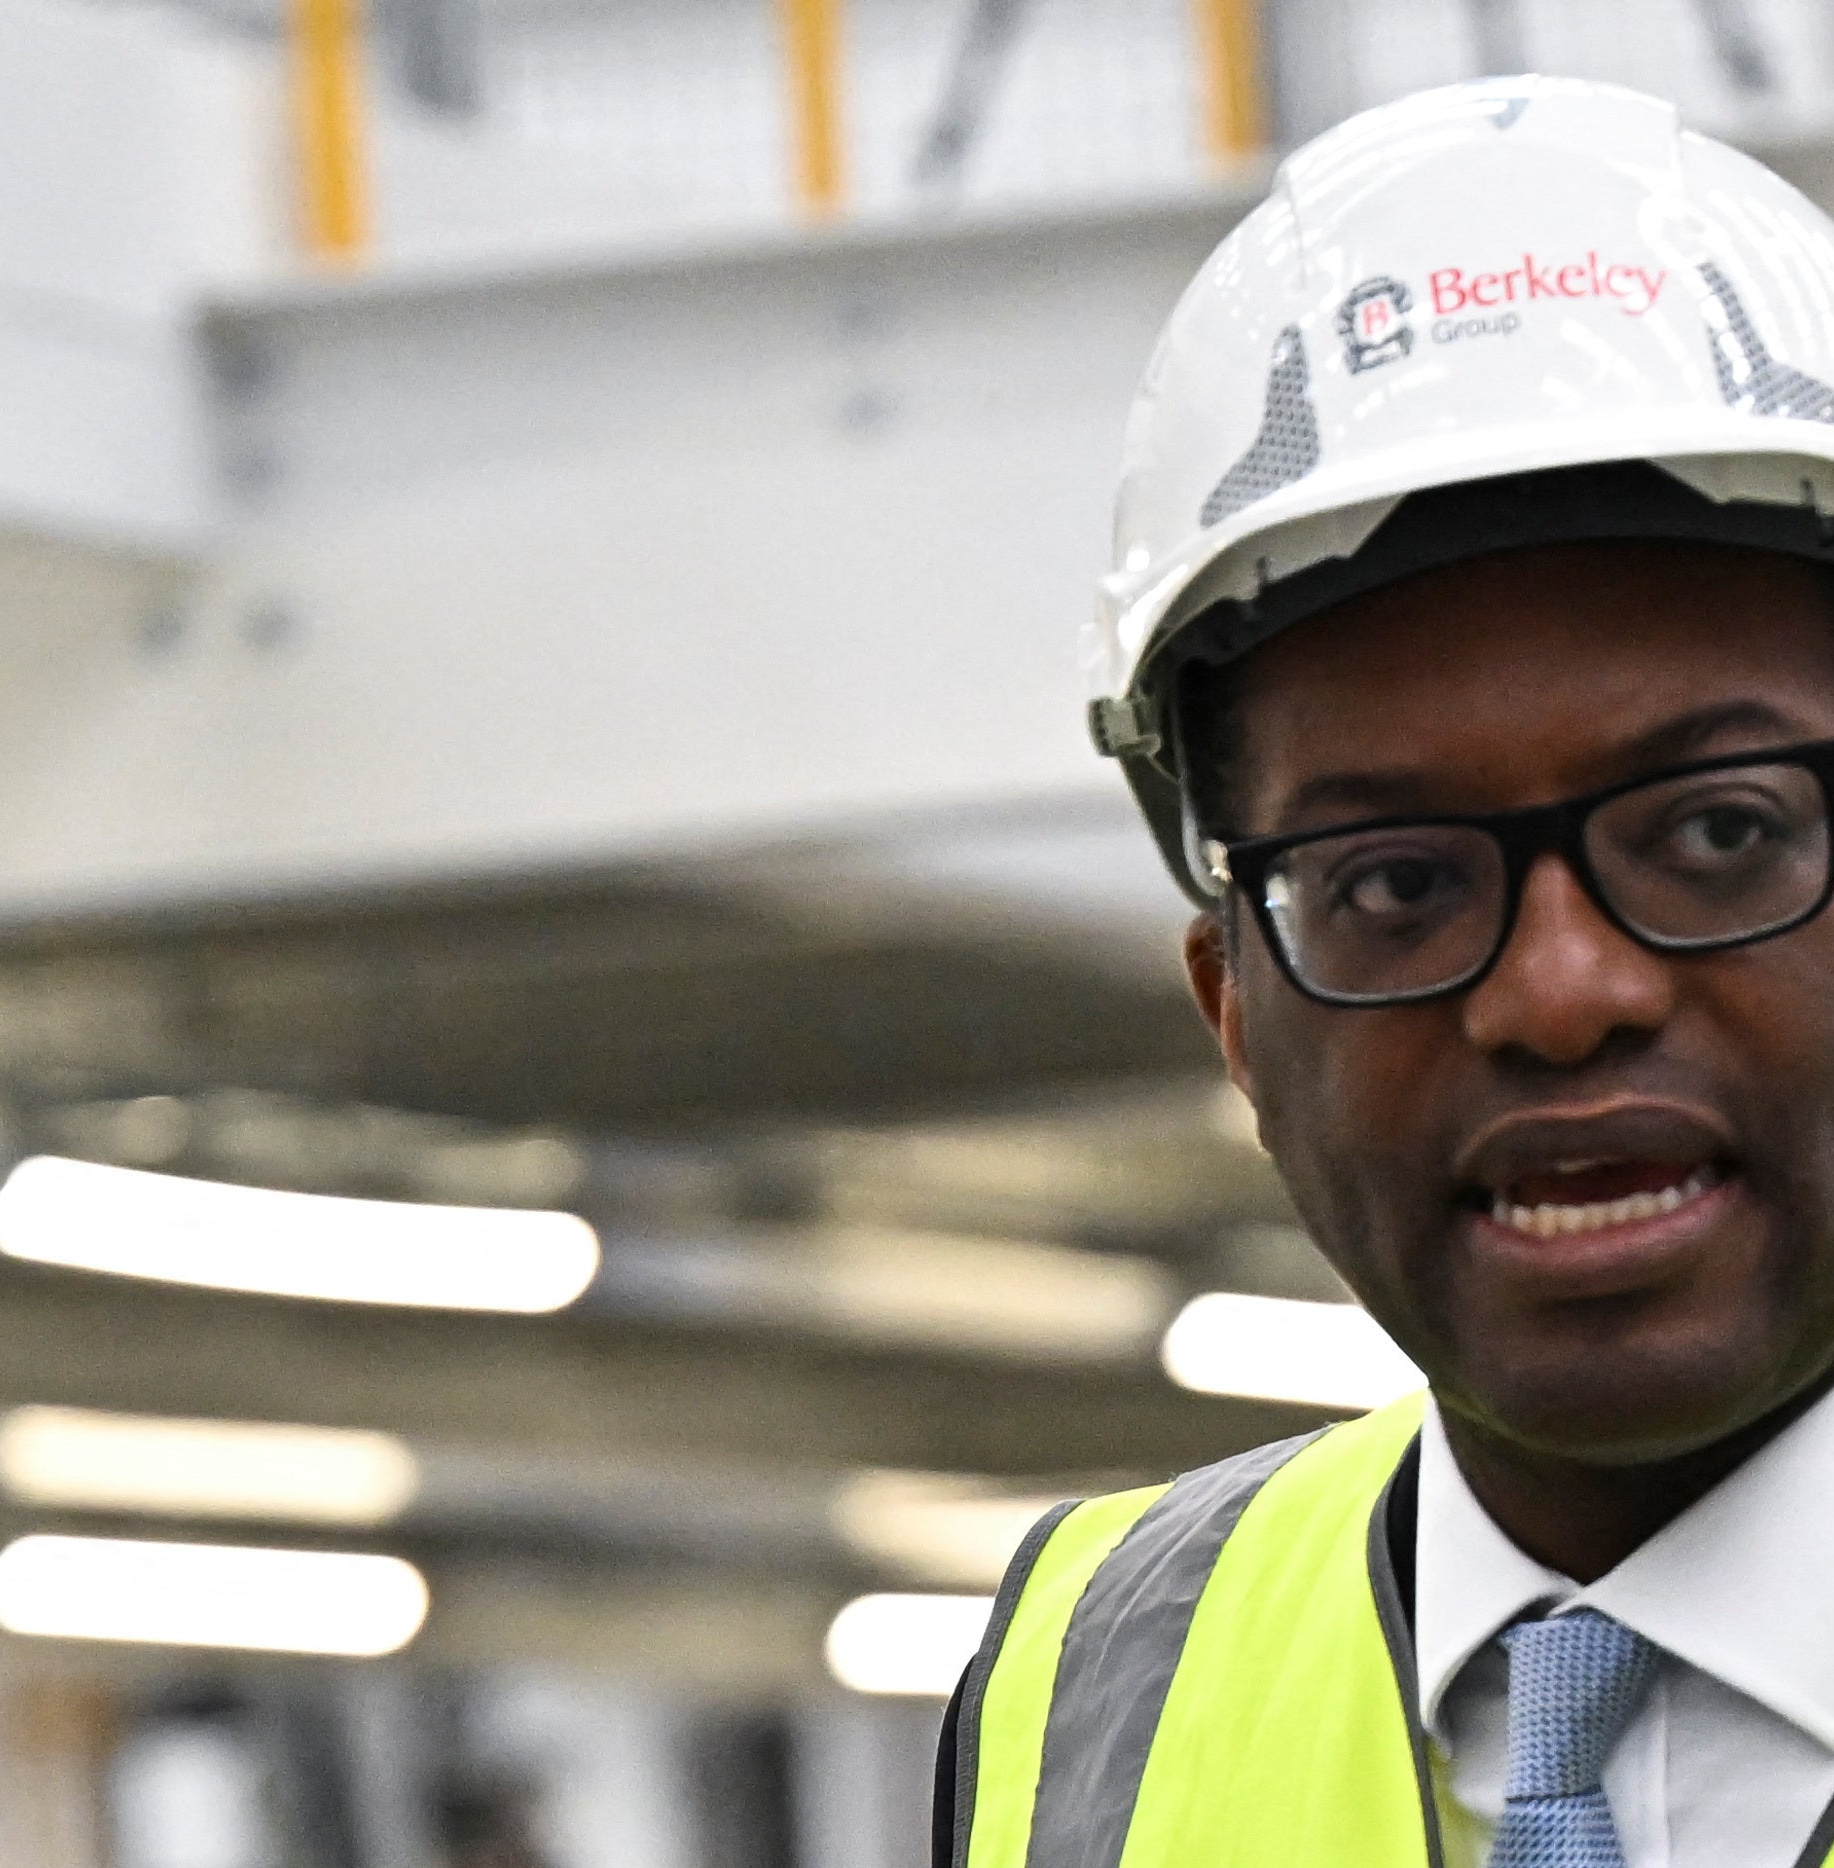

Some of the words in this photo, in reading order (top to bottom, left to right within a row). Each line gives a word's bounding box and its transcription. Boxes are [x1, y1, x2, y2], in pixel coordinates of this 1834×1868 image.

[1428, 249, 1667, 317] Berkeley
[1362, 301, 1390, 337] B
[1430, 311, 1521, 345] Group
